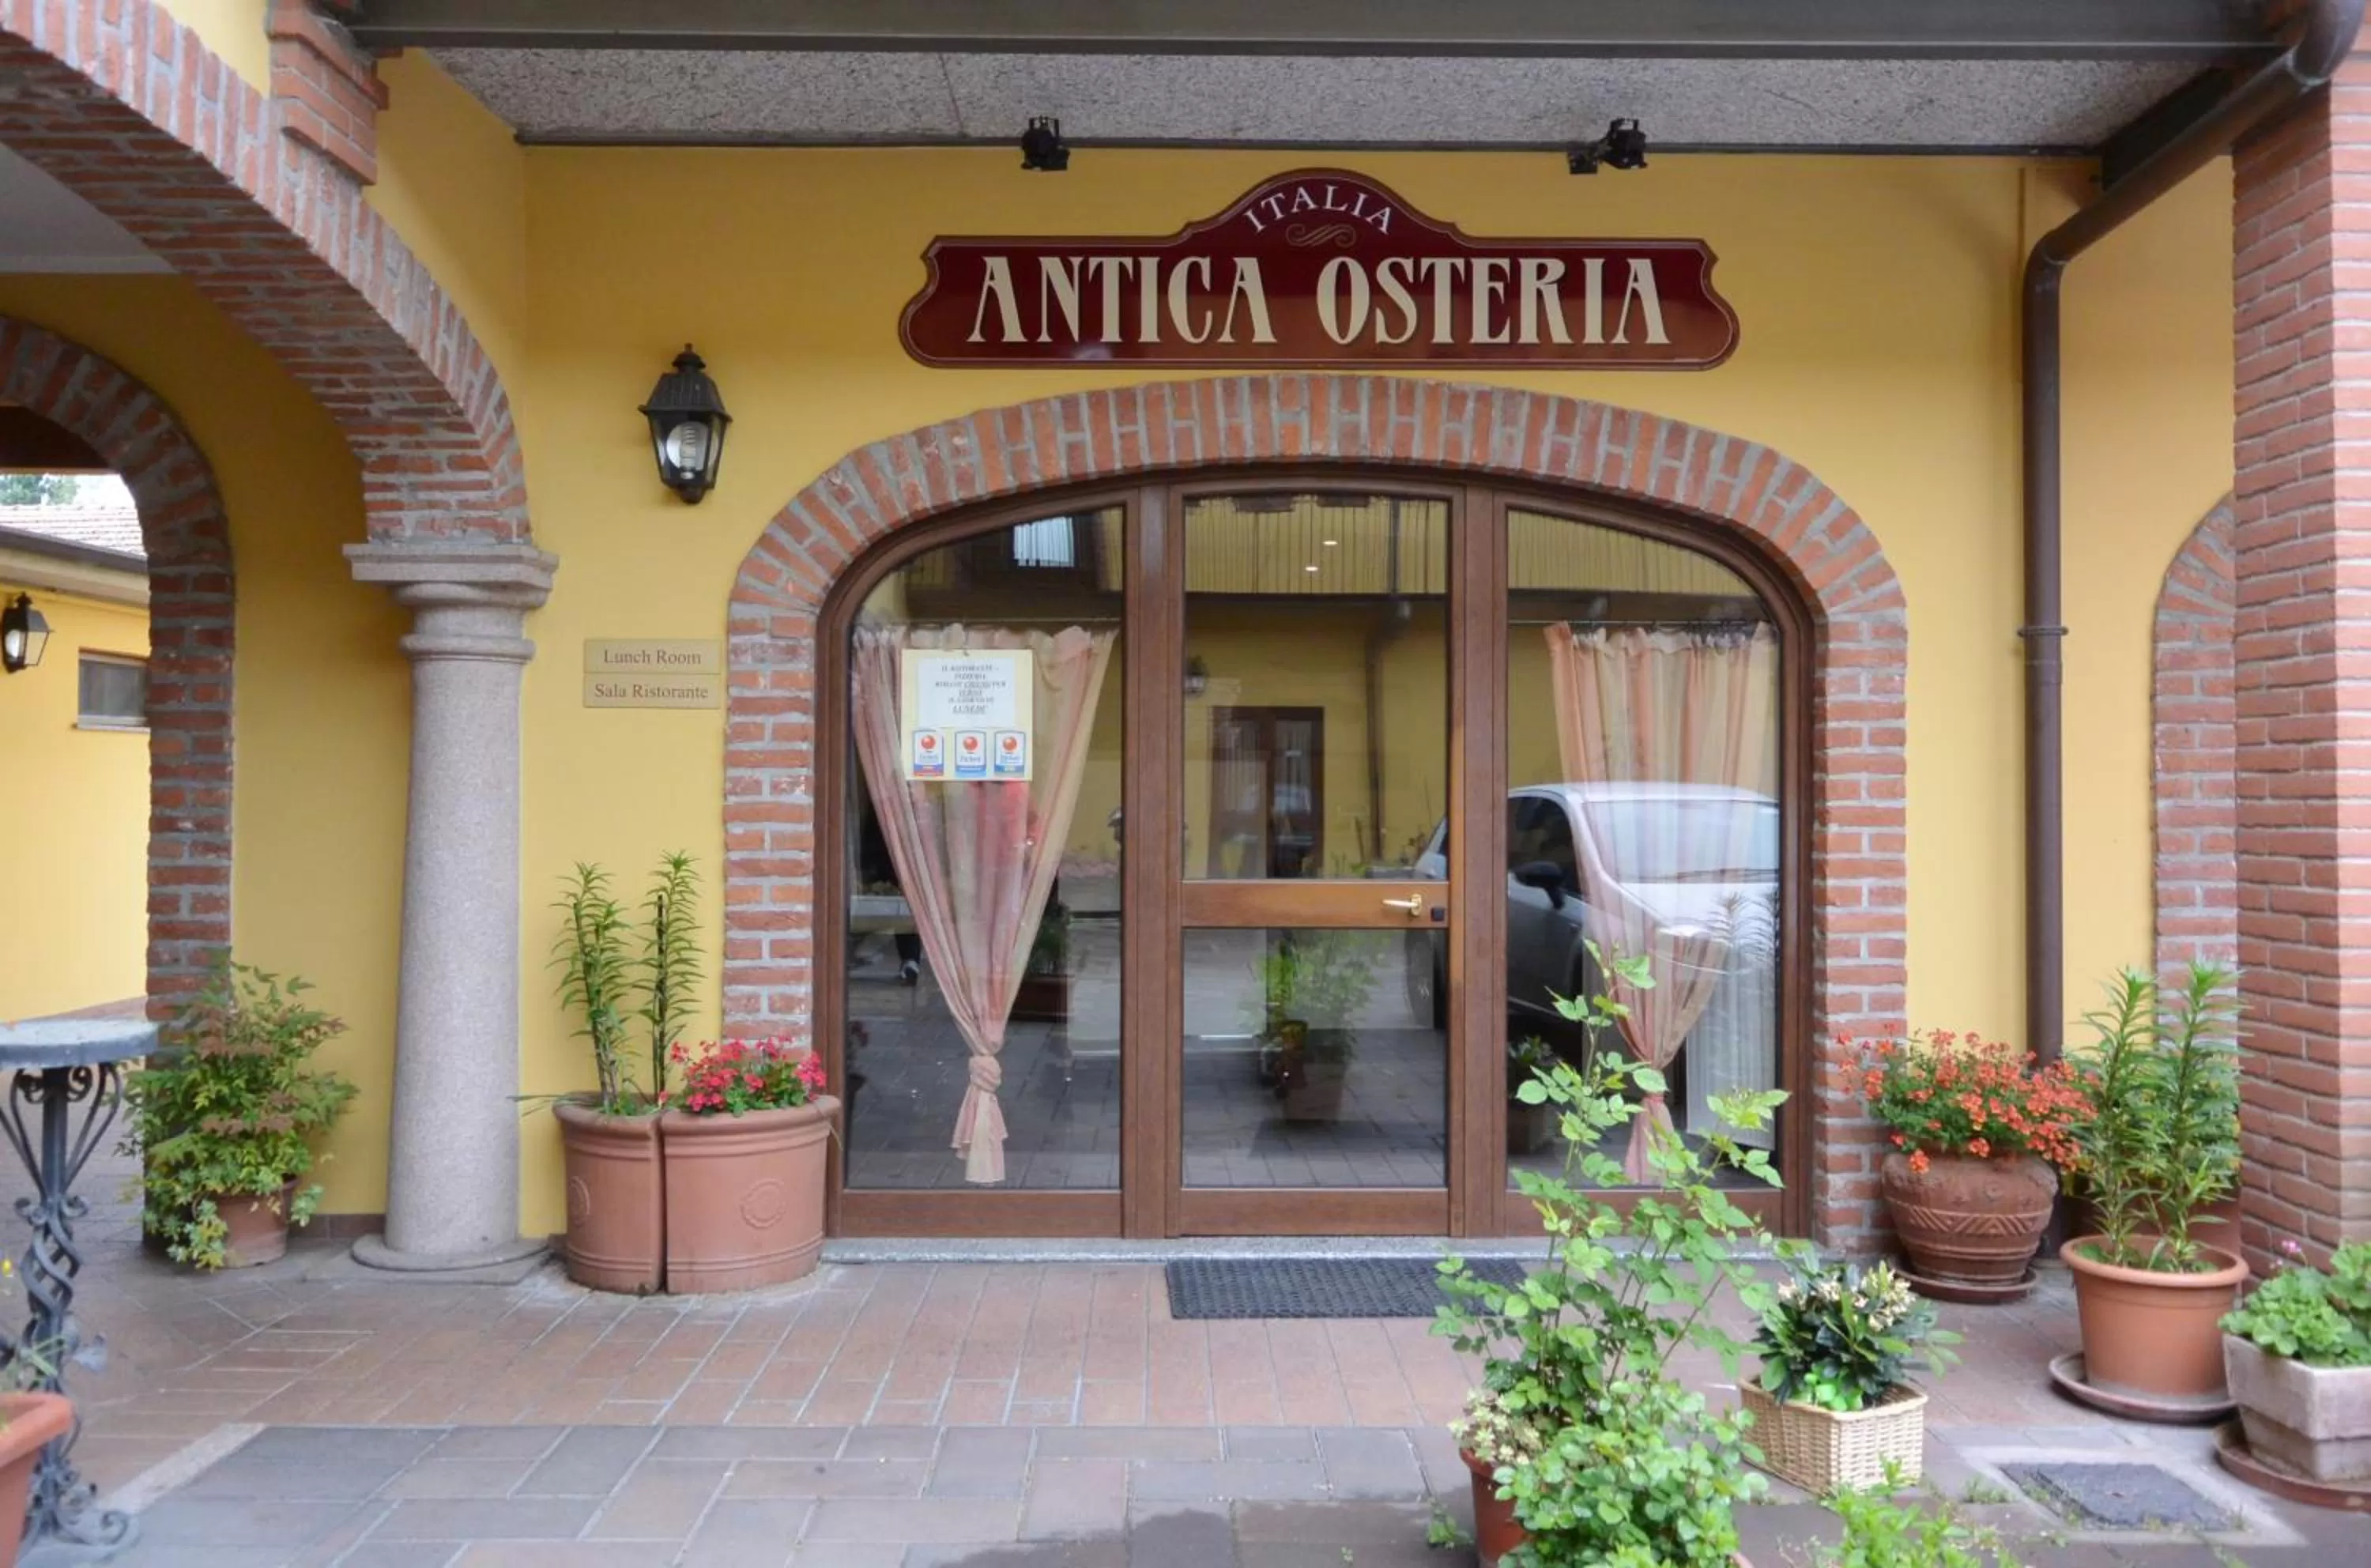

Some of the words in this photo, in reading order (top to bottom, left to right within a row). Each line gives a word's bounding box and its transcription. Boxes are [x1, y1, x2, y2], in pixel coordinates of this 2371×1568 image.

[1243, 177, 1392, 235] ITALIA
[967, 255, 1278, 345] ANTICA
[1316, 256, 1672, 345] OSTERIA
[603, 649, 651, 665] Lunch
[656, 649, 702, 666] Room
[594, 683, 628, 698] Sala
[632, 683, 709, 699] Ristorante
